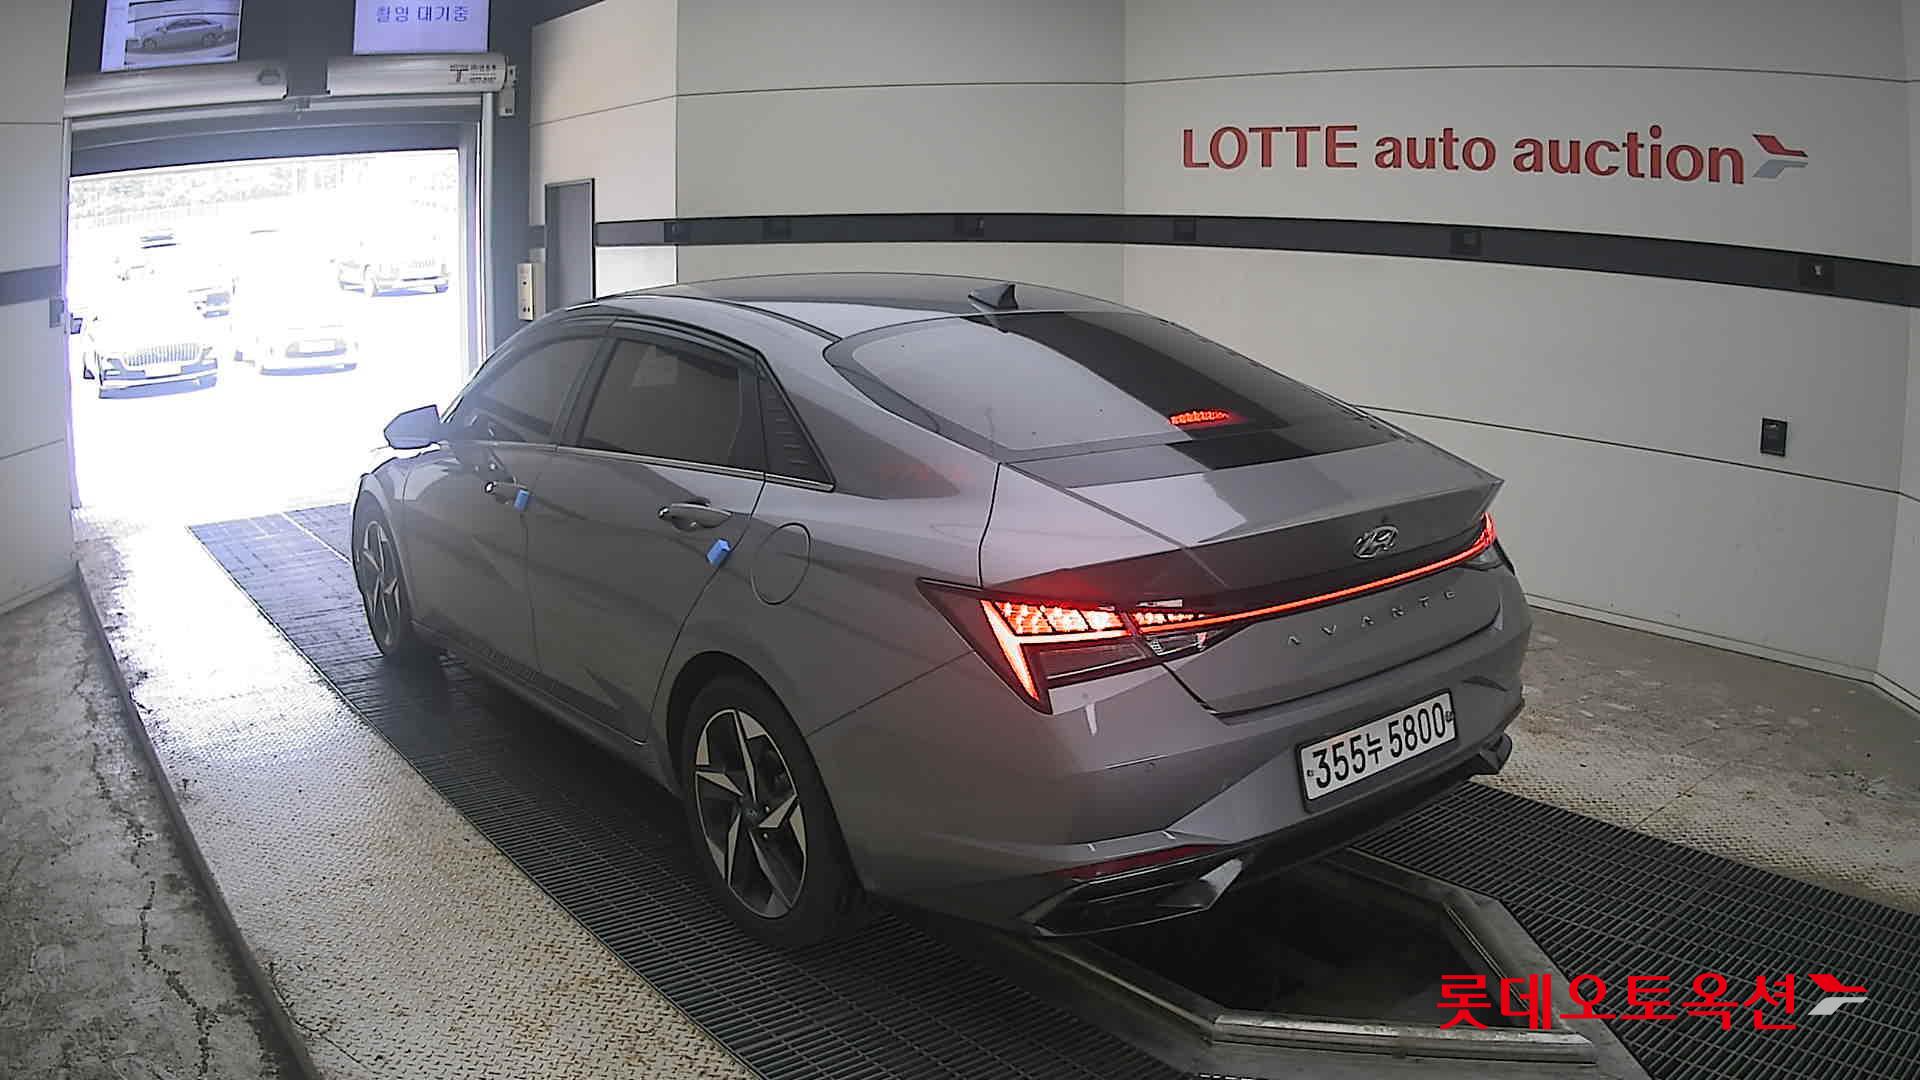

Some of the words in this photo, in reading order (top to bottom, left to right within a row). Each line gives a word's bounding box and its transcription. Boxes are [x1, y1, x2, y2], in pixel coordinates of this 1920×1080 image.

[417, 5, 469, 22] 대기중
[1183, 125, 1358, 170] LOTTE
[1375, 127, 1496, 171] auto
[1513, 125, 1745, 184] auction
[1287, 591, 1456, 646] AVANTE
[1311, 733, 1384, 788] 355누
[1388, 702, 1446, 758] 5800
